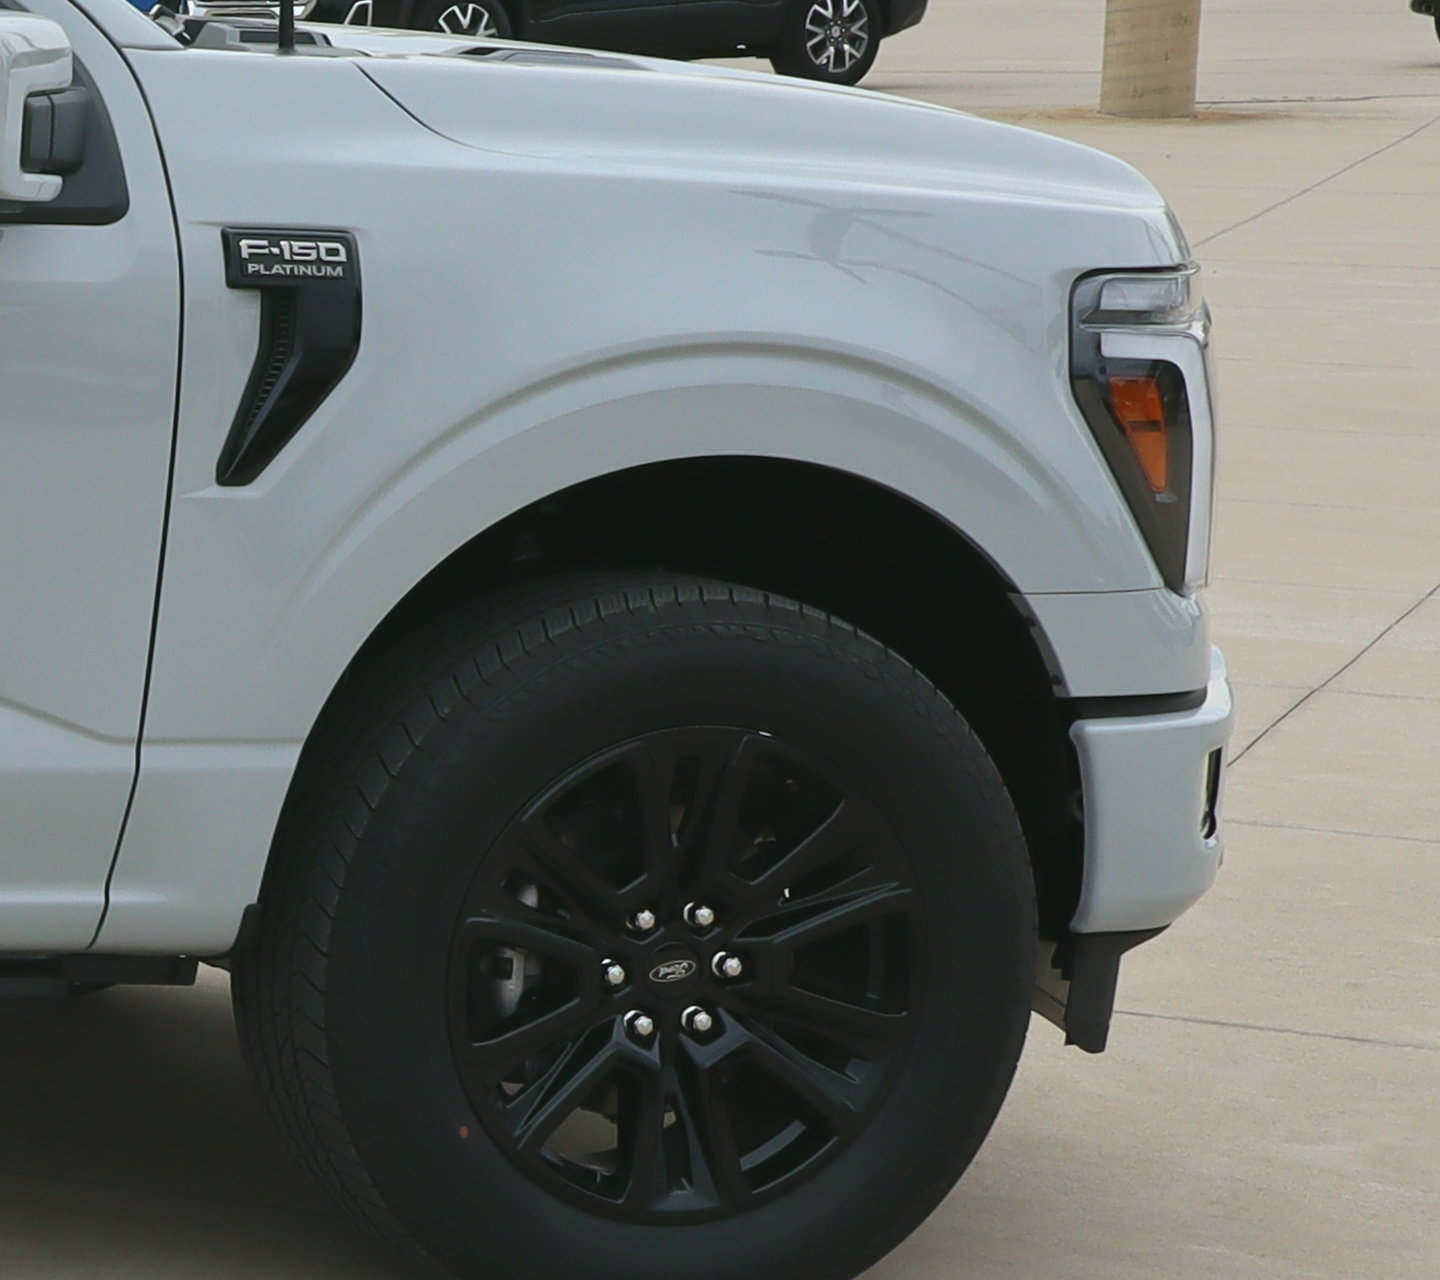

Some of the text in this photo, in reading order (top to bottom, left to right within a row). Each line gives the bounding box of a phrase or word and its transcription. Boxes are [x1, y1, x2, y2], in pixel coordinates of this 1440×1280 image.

[239, 239, 348, 262] F-150
[247, 263, 344, 277] PLATINUM
[657, 962, 689, 979] Ford
